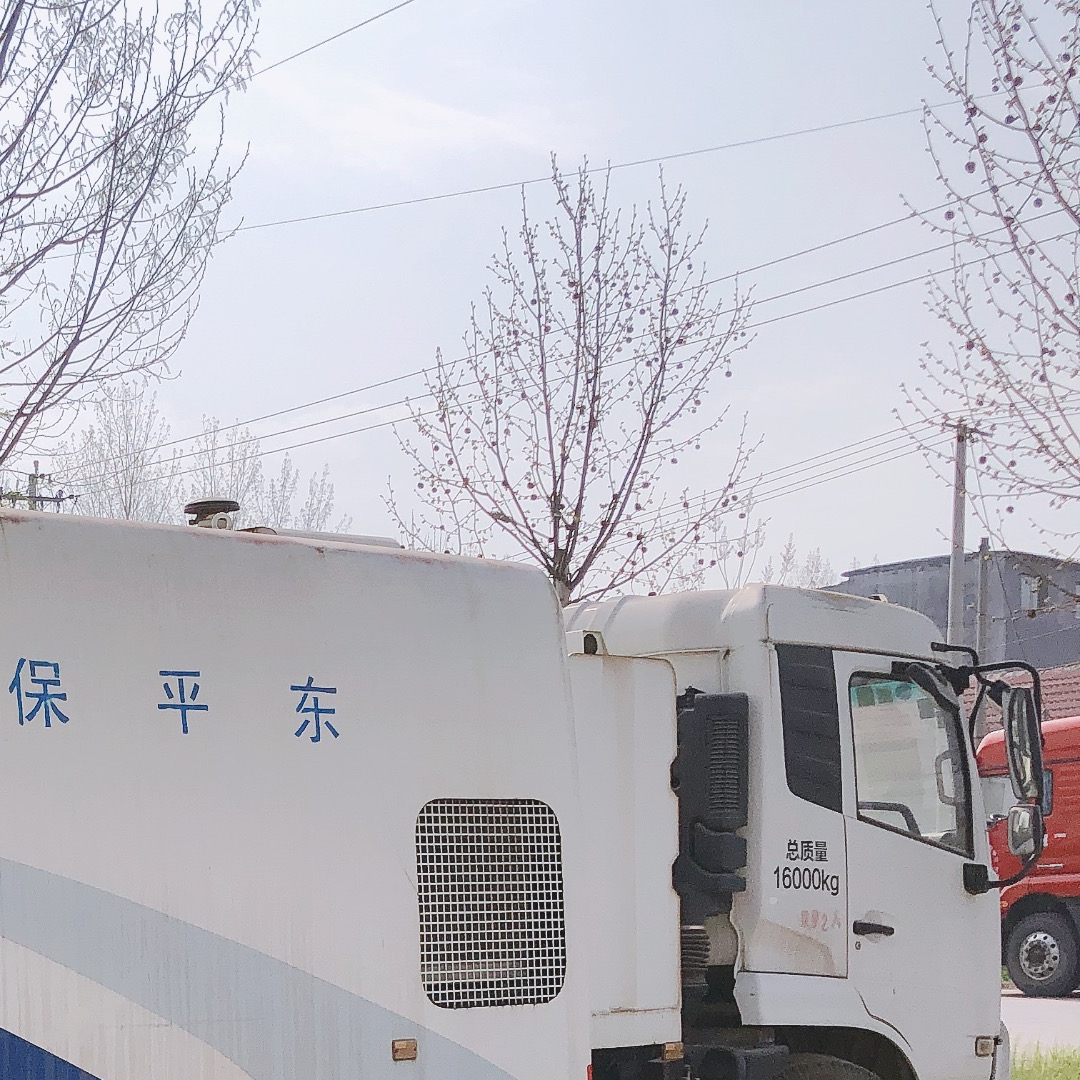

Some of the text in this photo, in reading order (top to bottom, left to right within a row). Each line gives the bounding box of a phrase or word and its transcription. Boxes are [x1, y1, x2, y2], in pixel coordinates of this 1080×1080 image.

[786, 839, 829, 862] 总质量
[773, 865, 840, 896] 16000kg
